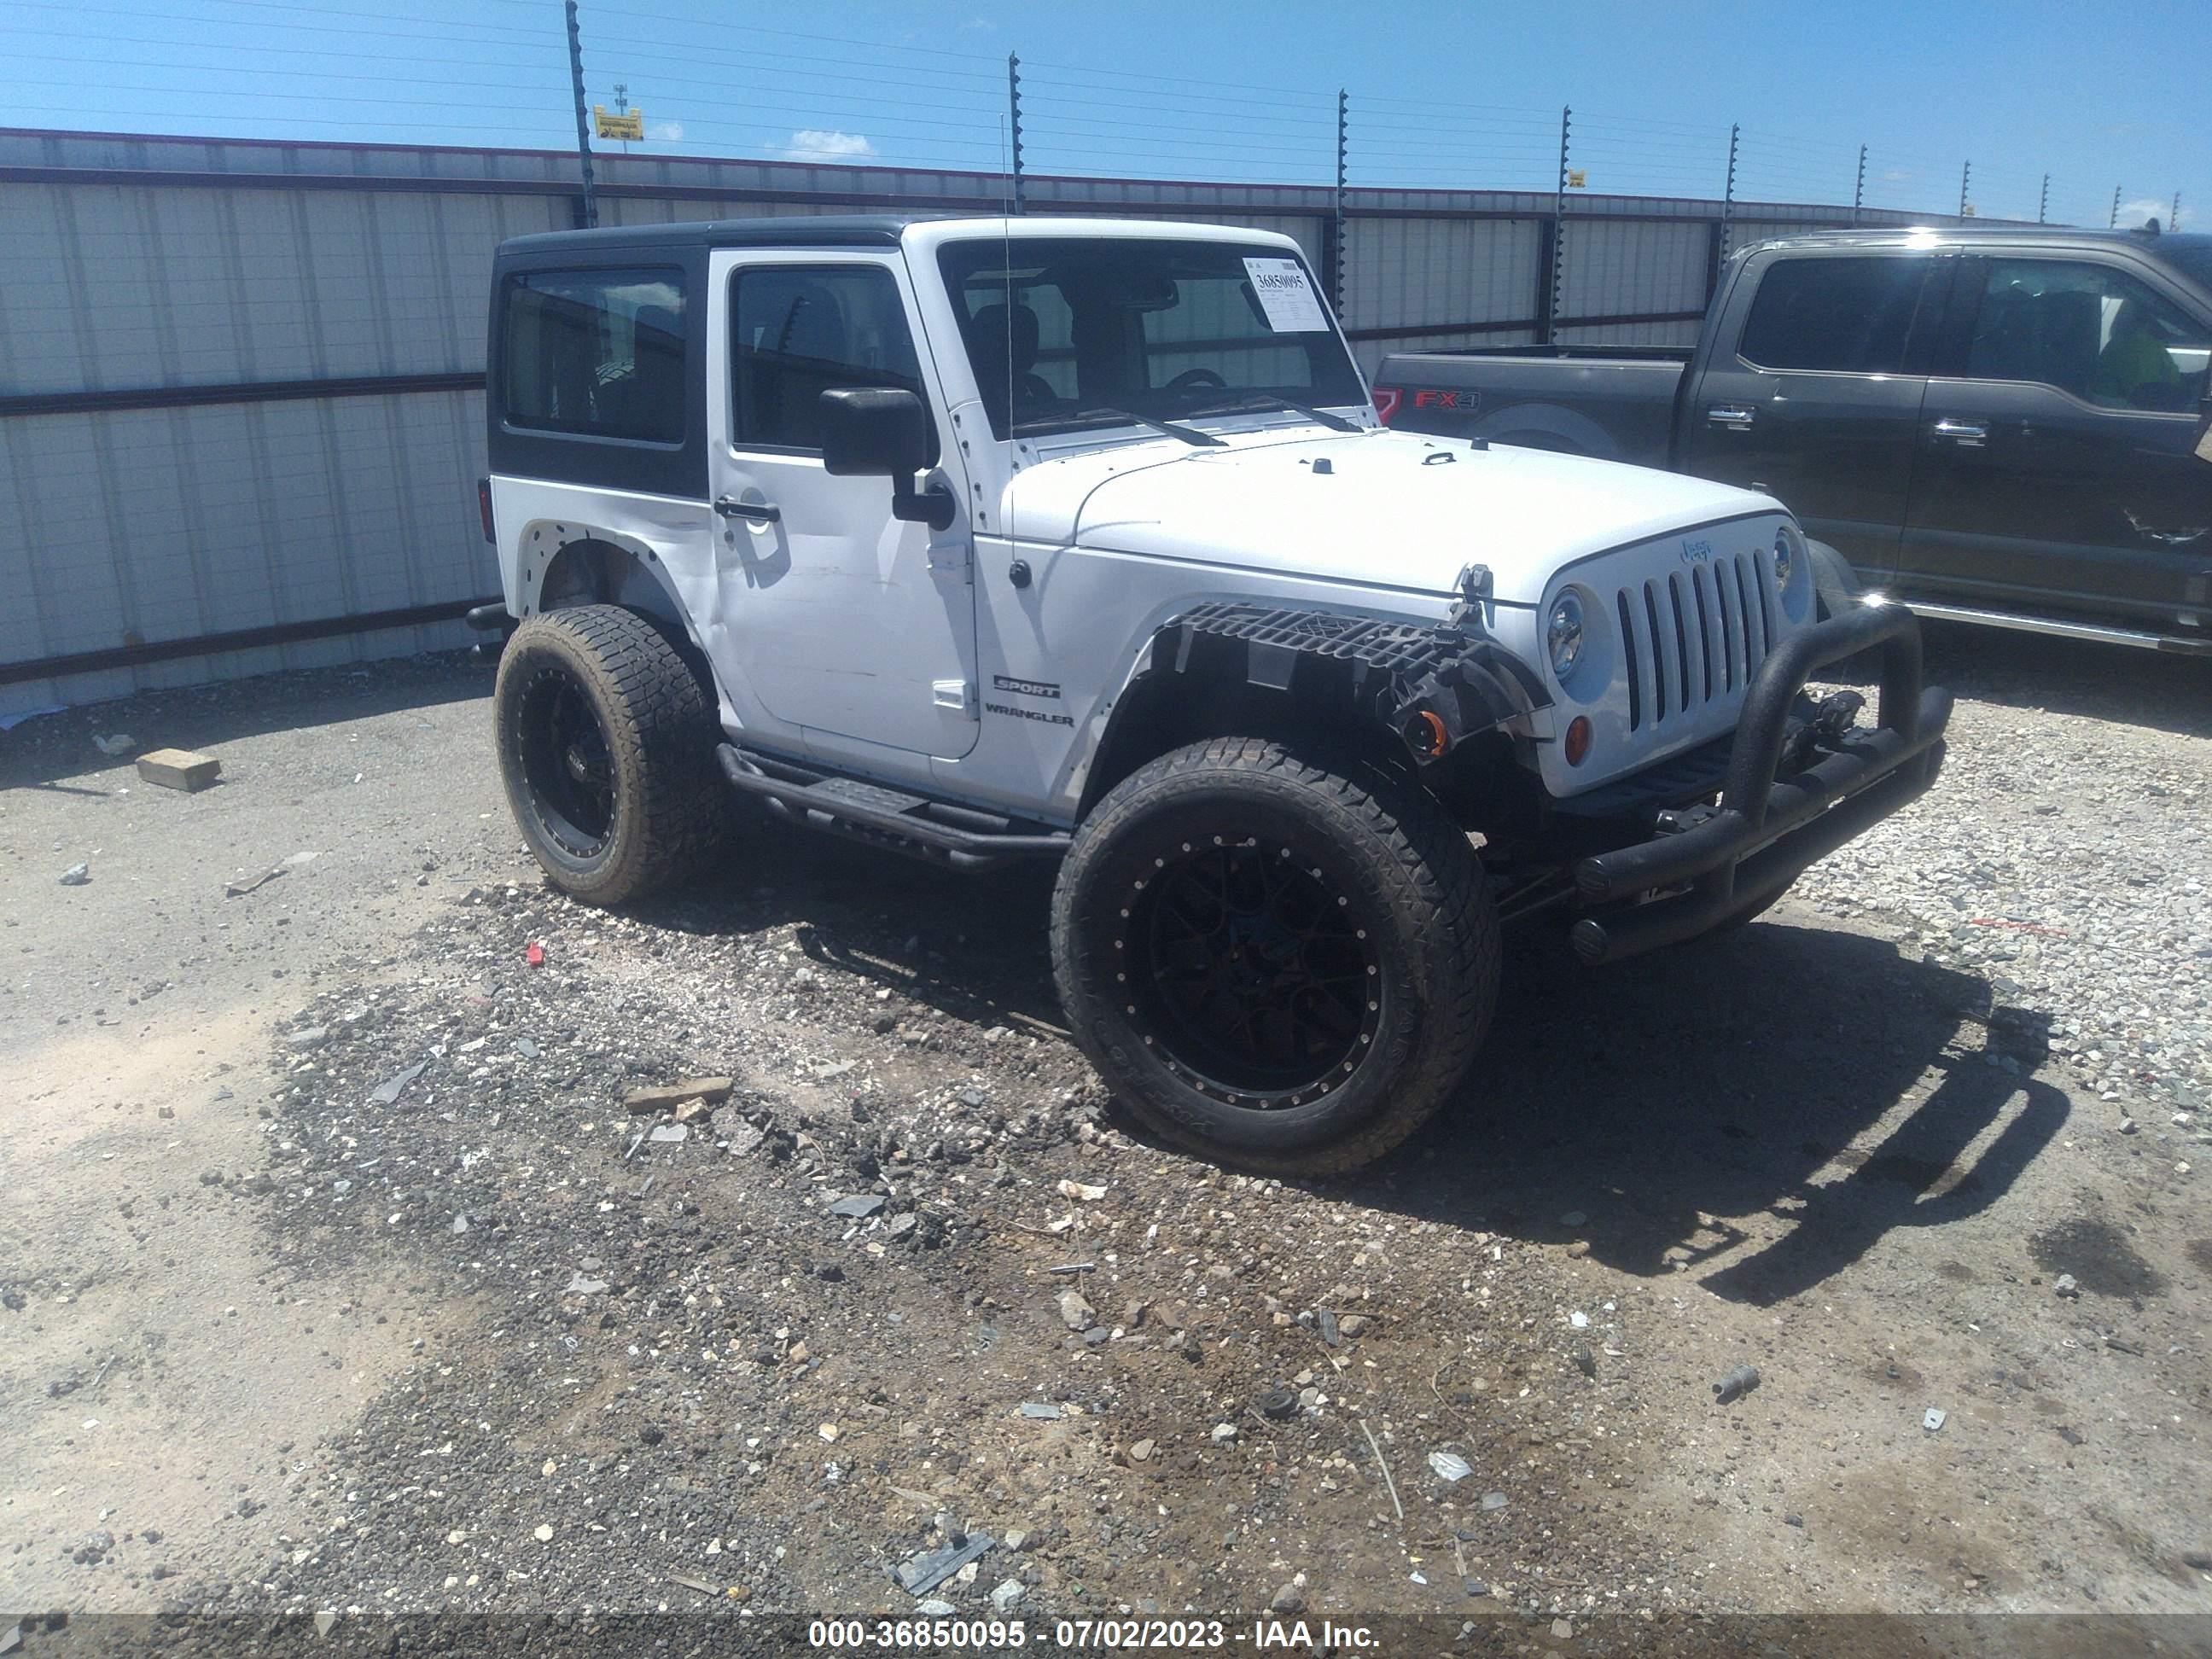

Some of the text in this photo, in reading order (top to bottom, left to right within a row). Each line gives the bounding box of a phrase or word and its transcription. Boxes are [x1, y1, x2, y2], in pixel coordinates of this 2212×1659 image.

[1256, 274, 1304, 288] 36850095
[1413, 389, 1481, 410] FX4
[1679, 540, 1712, 563] Jeep
[996, 679, 1057, 696] SPORT
[986, 702, 1074, 728] WRANGLER
